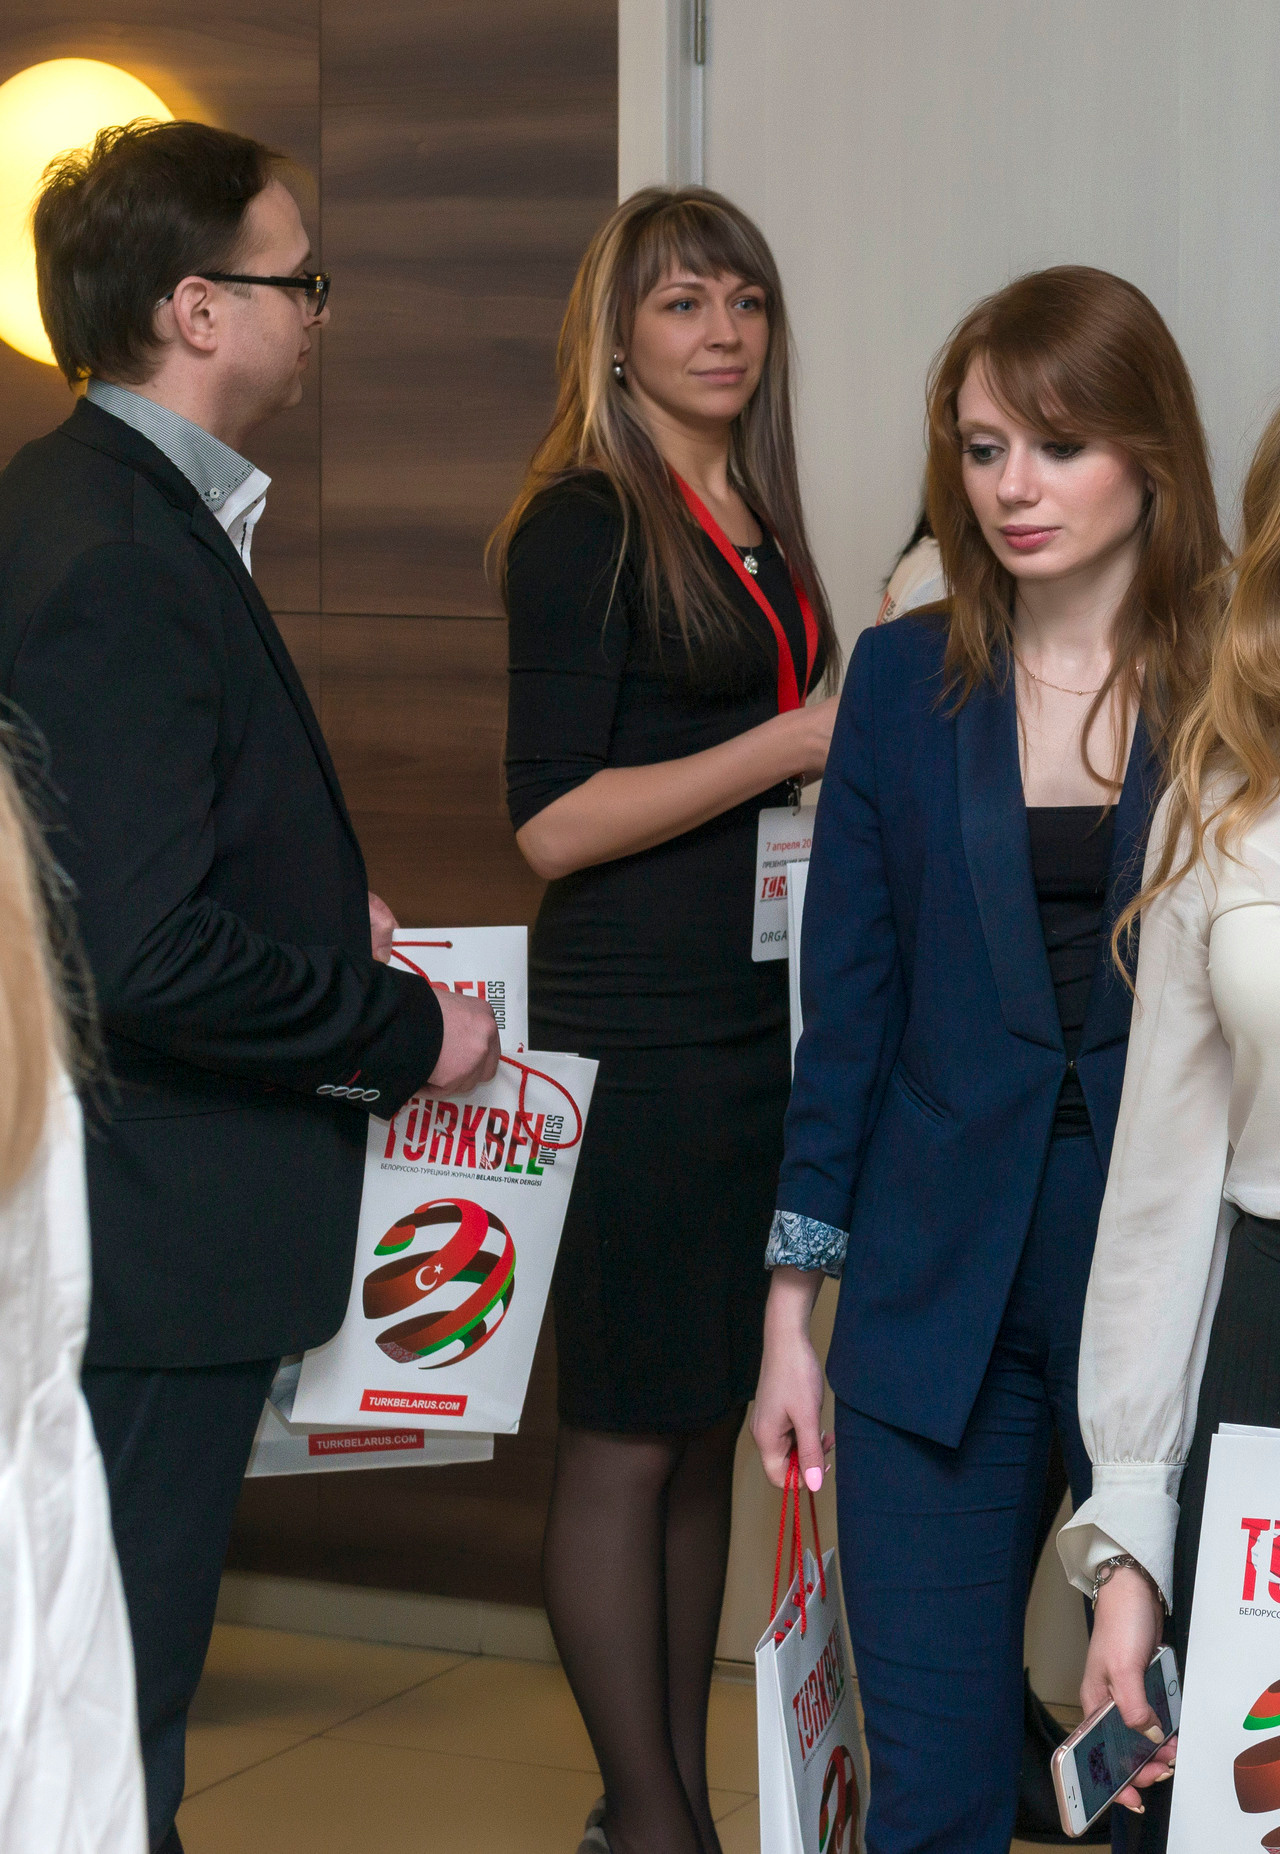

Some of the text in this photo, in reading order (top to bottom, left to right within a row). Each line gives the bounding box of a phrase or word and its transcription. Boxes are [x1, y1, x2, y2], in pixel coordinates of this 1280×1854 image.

[766, 841, 771, 852] 7
[369, 1396, 460, 1411] TURKBELARUS.COM
[316, 1434, 417, 1449] TURKBELARUS.COM
